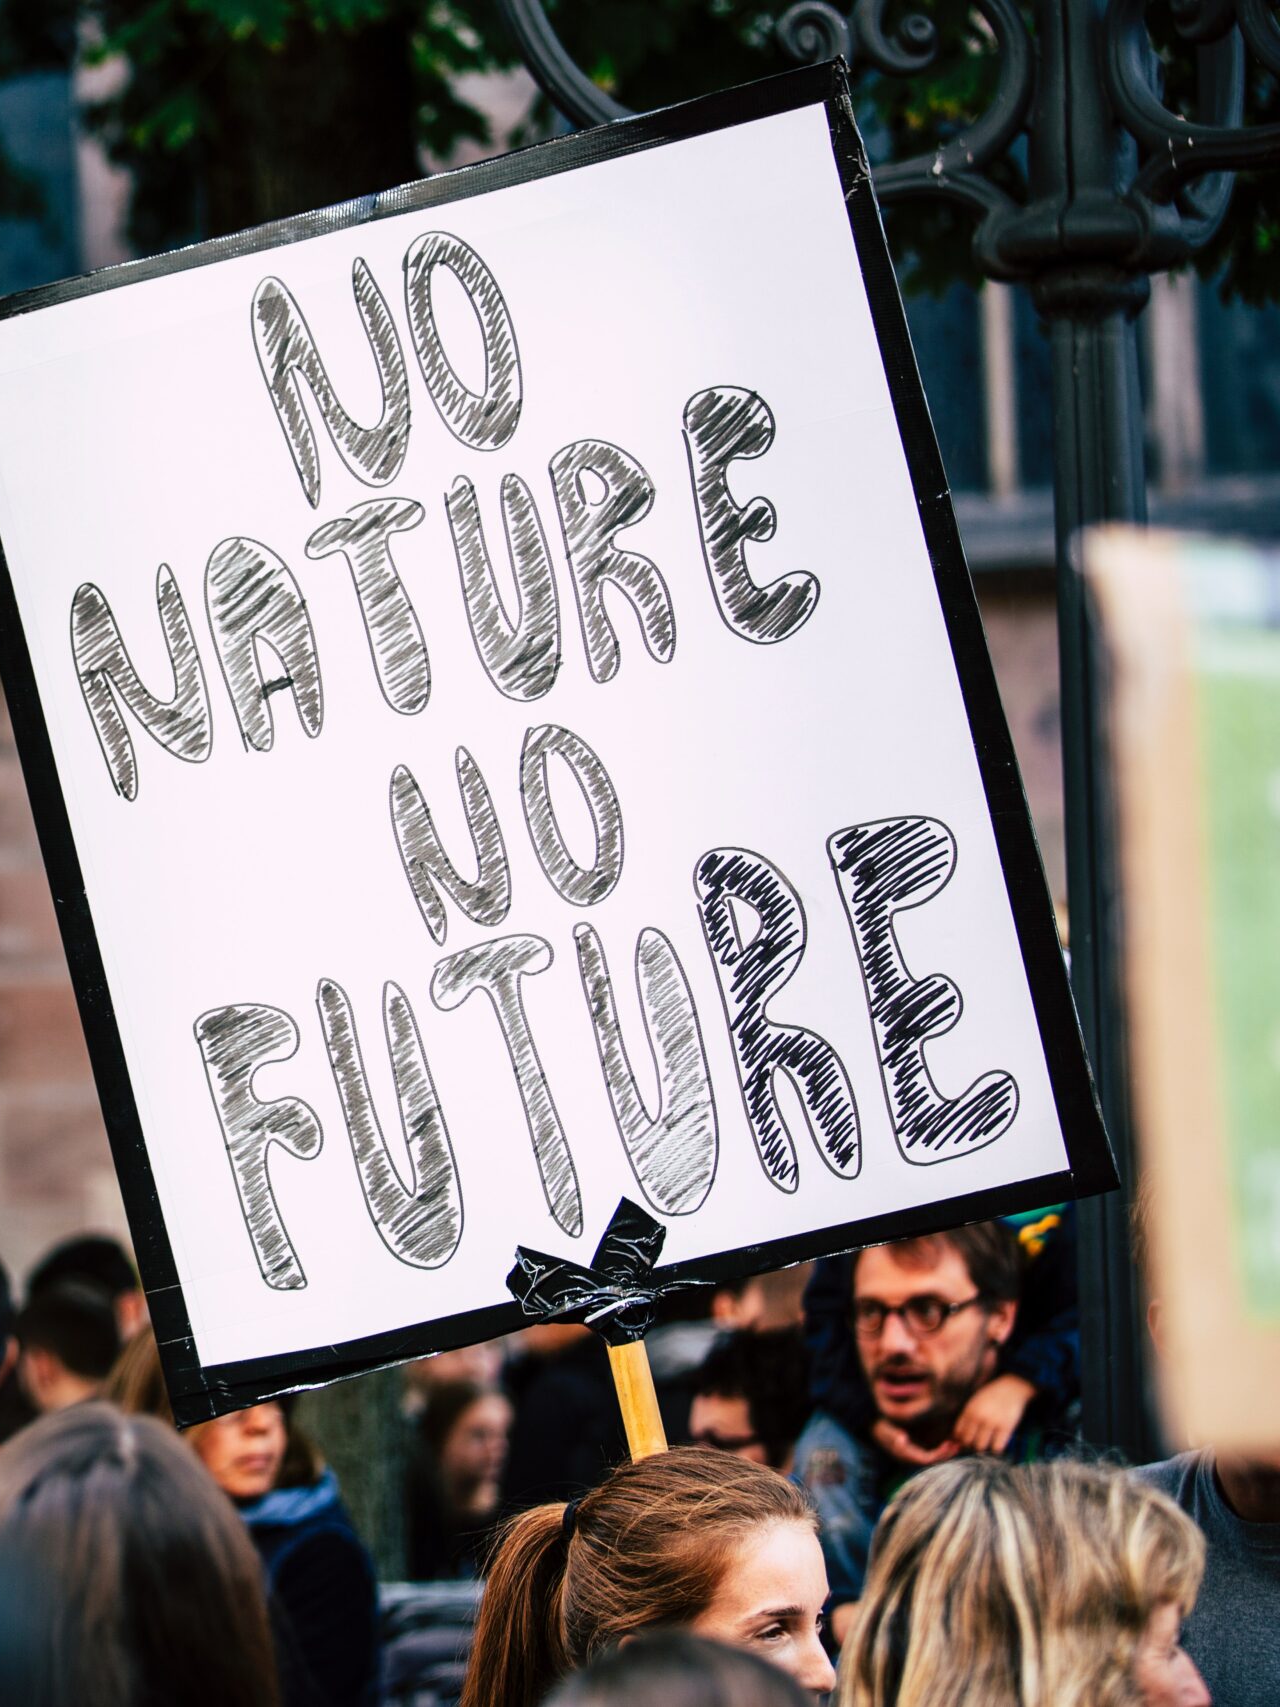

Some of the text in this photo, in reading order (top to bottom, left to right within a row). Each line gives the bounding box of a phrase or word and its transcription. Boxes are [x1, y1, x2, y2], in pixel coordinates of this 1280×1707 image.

[251, 231, 523, 509] NO
[70, 385, 821, 802] NATURE
[389, 724, 624, 946] NO
[193, 815, 1020, 1291] FUTURE
